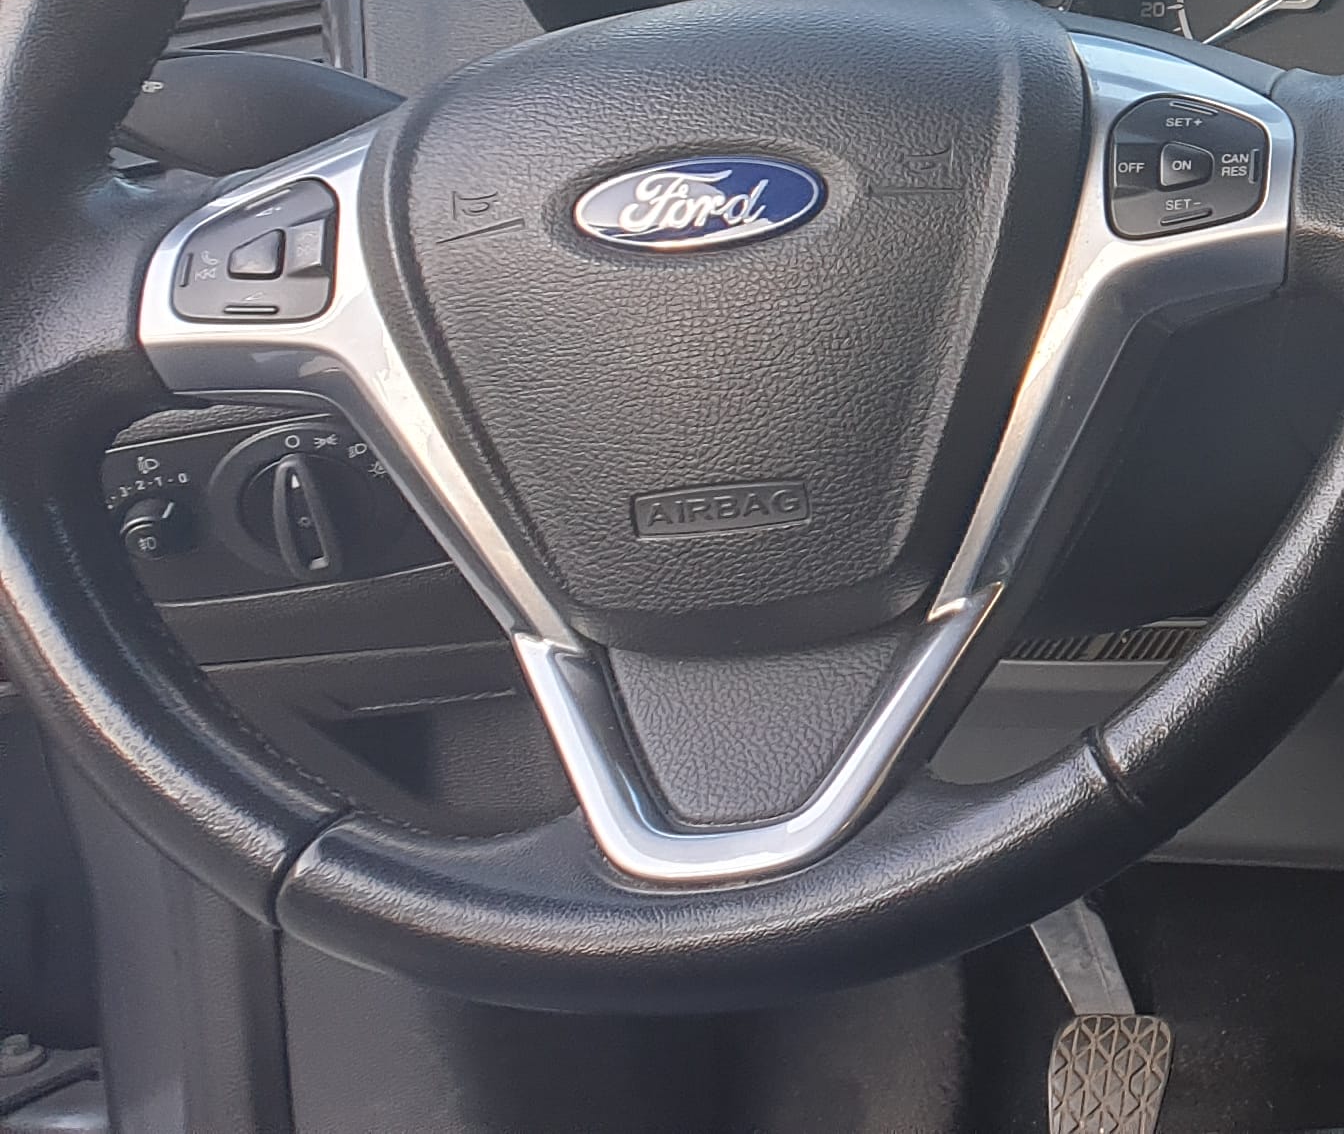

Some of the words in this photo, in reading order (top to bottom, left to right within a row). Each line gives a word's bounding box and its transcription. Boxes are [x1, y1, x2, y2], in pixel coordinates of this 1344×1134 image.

[1141, 2, 1165, 17] 20
[1221, 153, 1249, 164] CAN
[1117, 162, 1145, 173] OFF
[1172, 161, 1192, 171] ON
[1221, 166, 1247, 177] RES
[618, 170, 769, 233] Ford
[646, 488, 800, 529] AIRBAG
